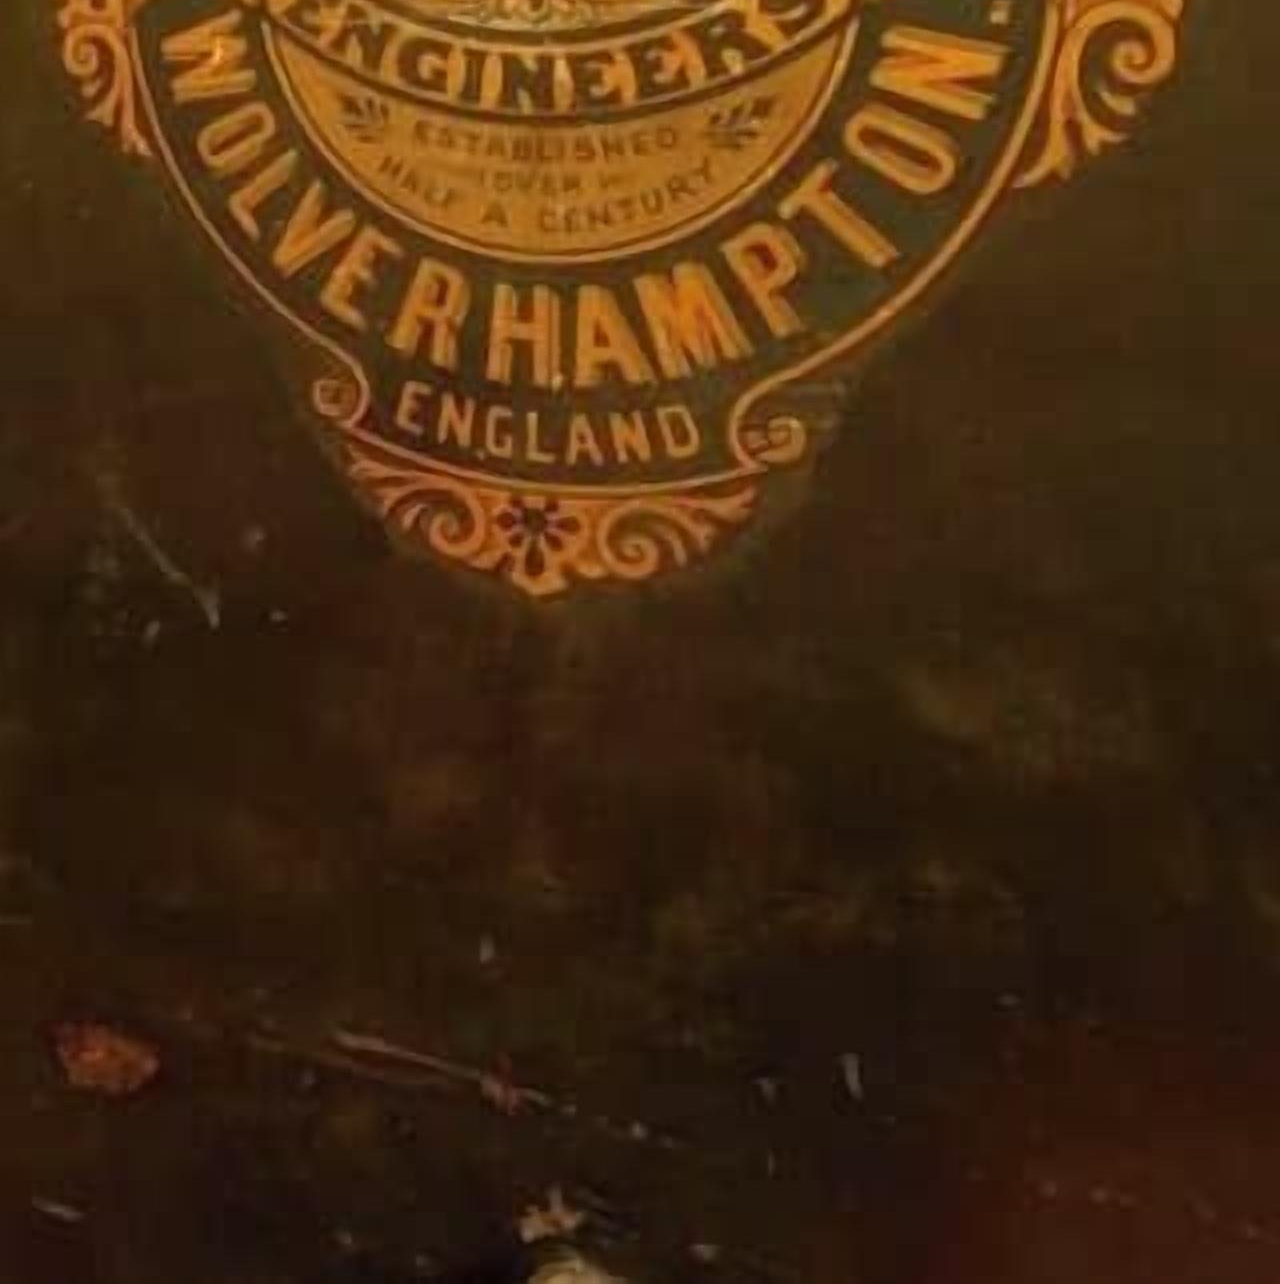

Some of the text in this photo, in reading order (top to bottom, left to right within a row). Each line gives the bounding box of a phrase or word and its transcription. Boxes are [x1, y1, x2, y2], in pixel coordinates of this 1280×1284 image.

[413, 123, 682, 162] ESTABLISHED
[480, 202, 509, 228] A
[538, 155, 715, 234] CENTURY
[397, 381, 700, 464] ENGLAND
